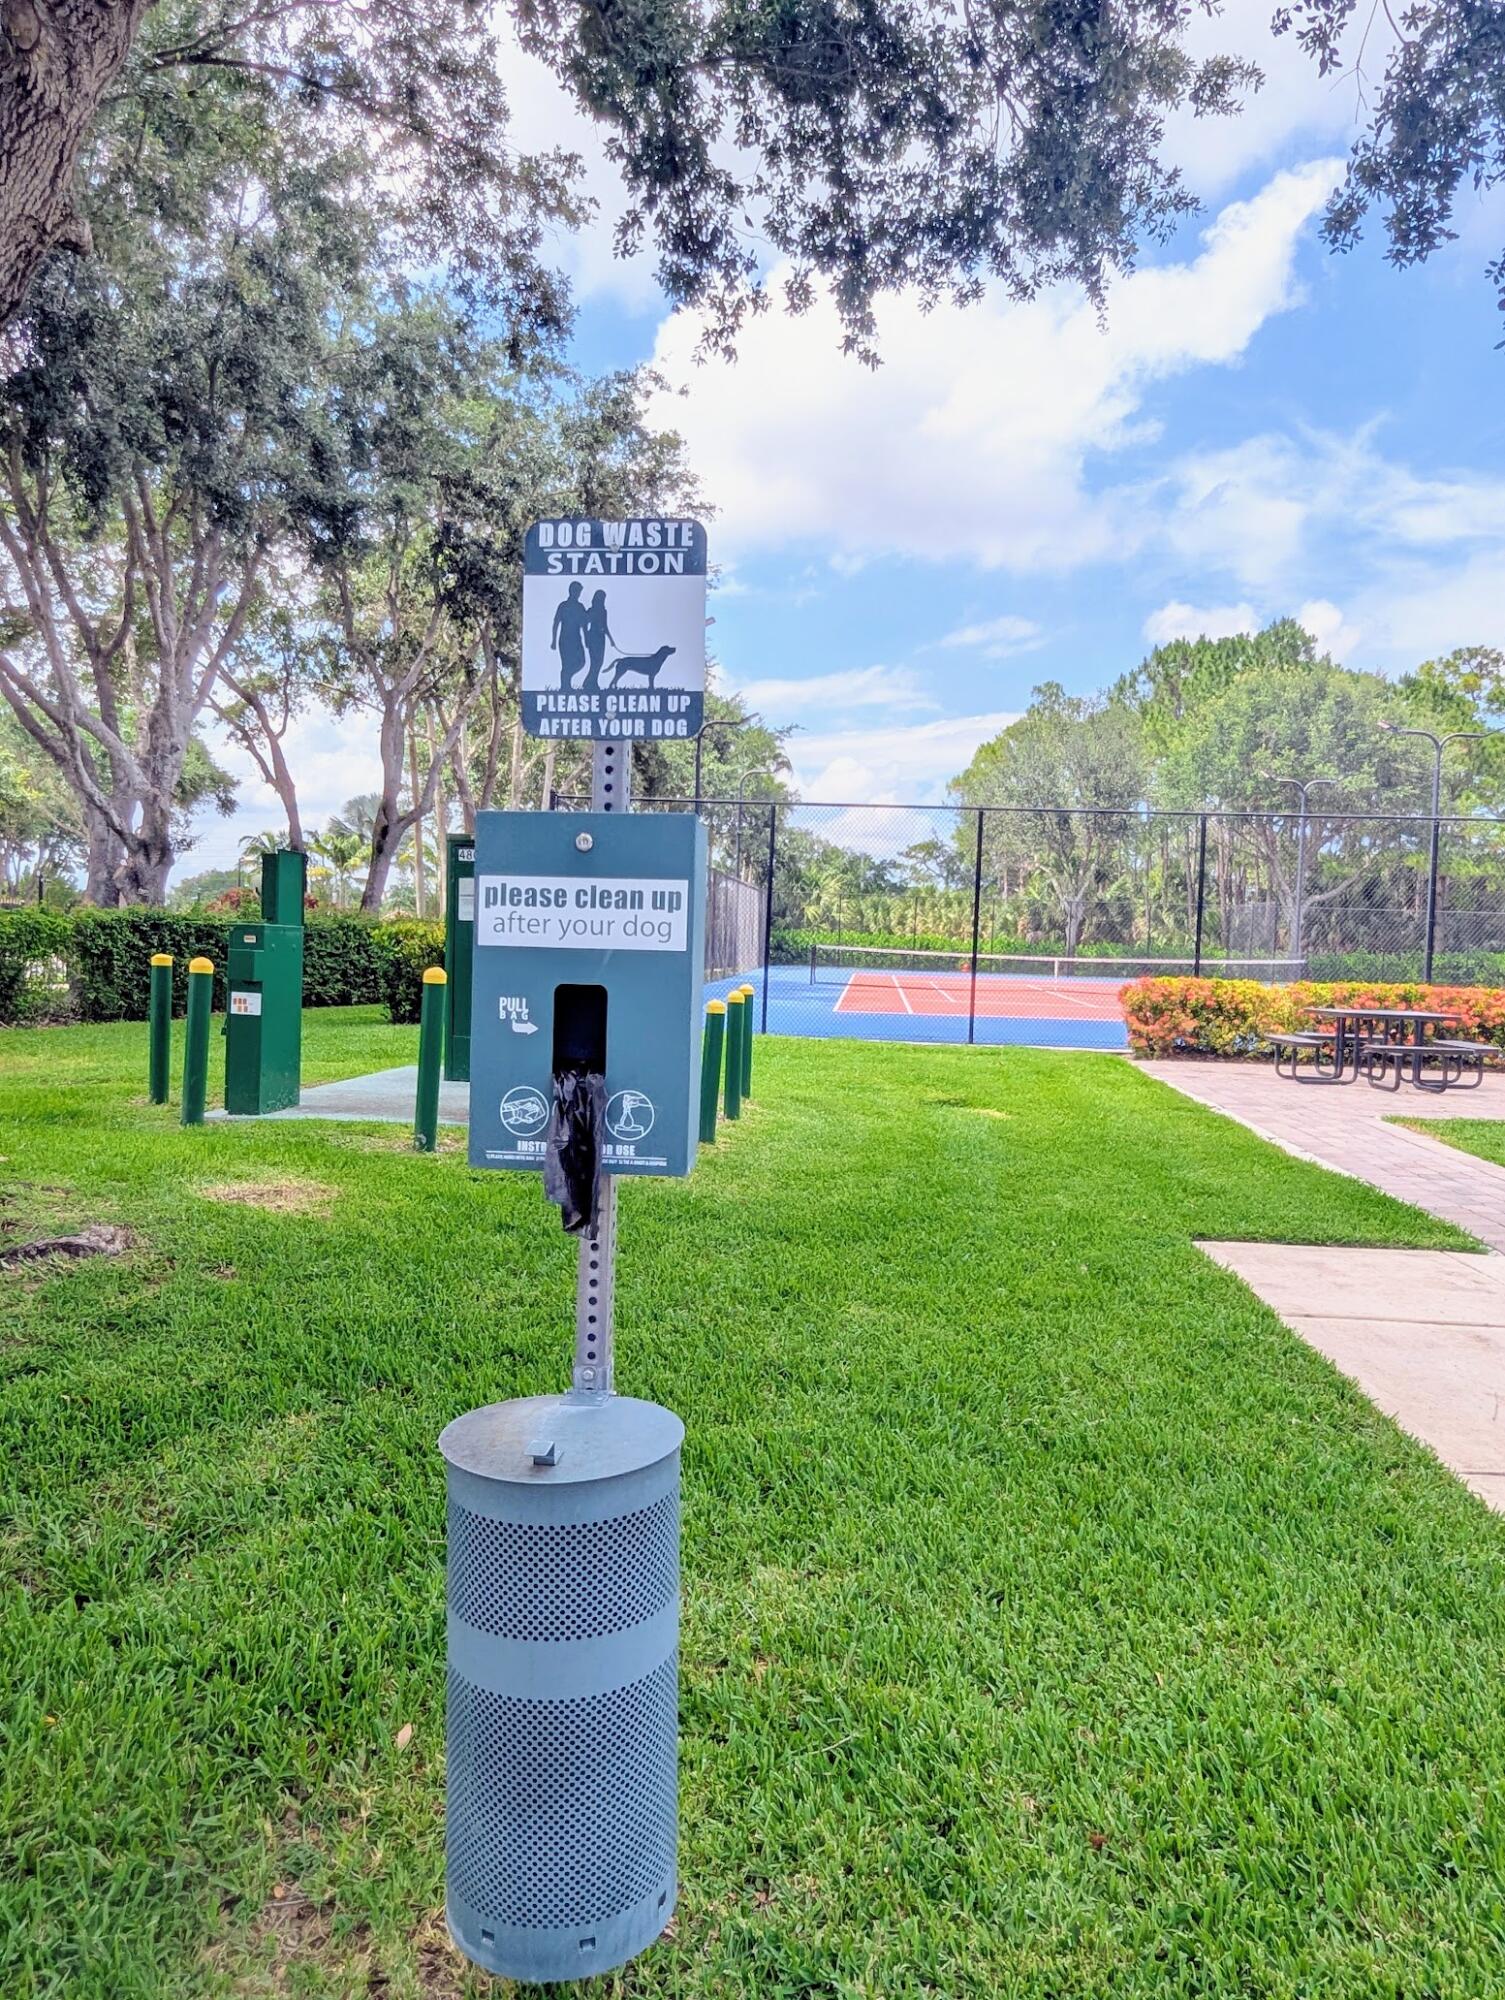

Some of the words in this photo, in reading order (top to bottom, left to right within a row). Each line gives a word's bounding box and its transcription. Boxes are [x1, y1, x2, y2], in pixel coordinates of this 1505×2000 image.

[539, 522, 591, 547] DOG
[603, 522, 693, 547] WASTE
[548, 552, 684, 574] STATION
[536, 695, 600, 713] PLEASE
[605, 695, 660, 713] CLEAN
[667, 695, 691, 713] UP
[539, 719, 592, 736] AFTER
[599, 719, 645, 736] YOUR
[652, 719, 688, 736] DOG
[459, 850, 475, 860] 48
[484, 883, 567, 909] please
[575, 885, 643, 910] clean
[651, 890, 682, 913] up
[493, 911, 551, 934] after
[558, 918, 615, 941] your
[623, 915, 672, 943] dog
[499, 997, 528, 1011] PULL
[615, 1145, 636, 1156] USE
